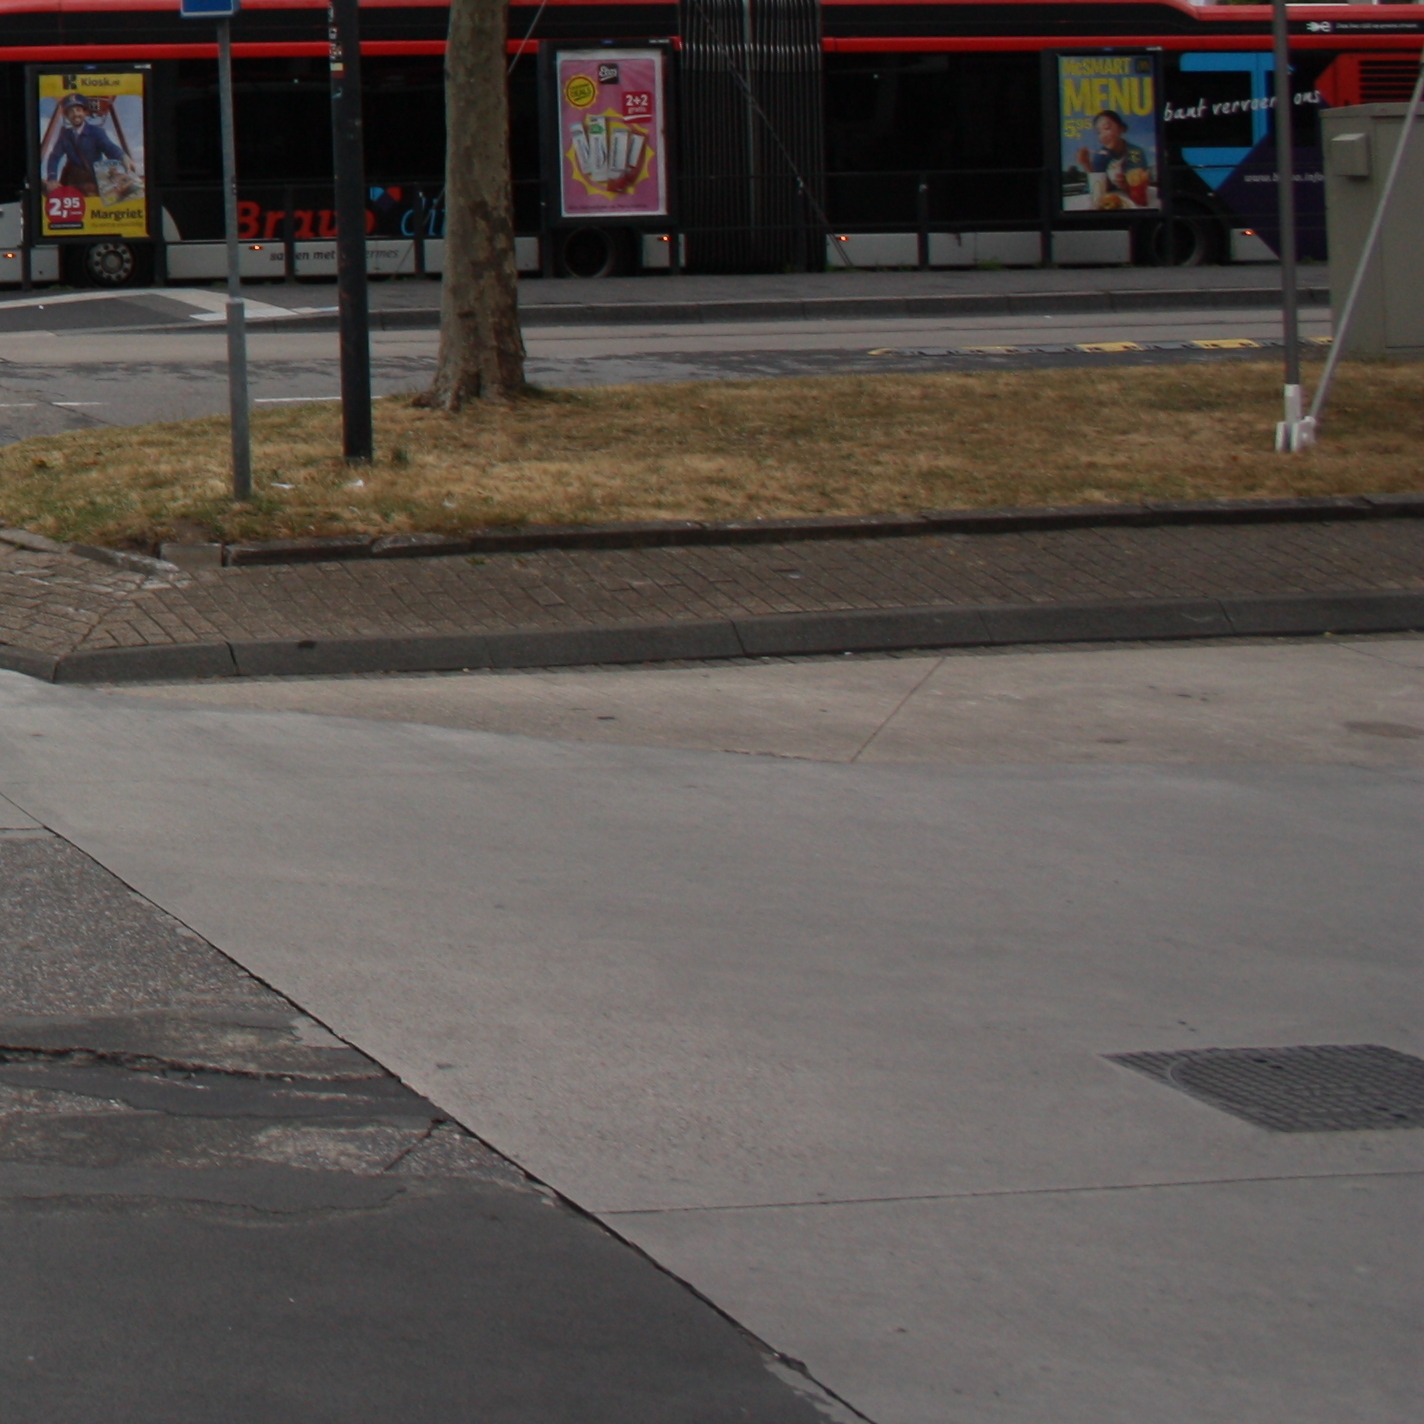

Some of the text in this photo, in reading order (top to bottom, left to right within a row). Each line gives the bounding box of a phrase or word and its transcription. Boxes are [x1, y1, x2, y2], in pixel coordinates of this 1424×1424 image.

[625, 94, 649, 107] 2+2
[1063, 77, 1153, 117] MENU
[1293, 89, 1320, 105] ons
[49, 196, 81, 219] 2,95
[90, 208, 144, 222] Margriet
[269, 248, 399, 261] saen met ermes
